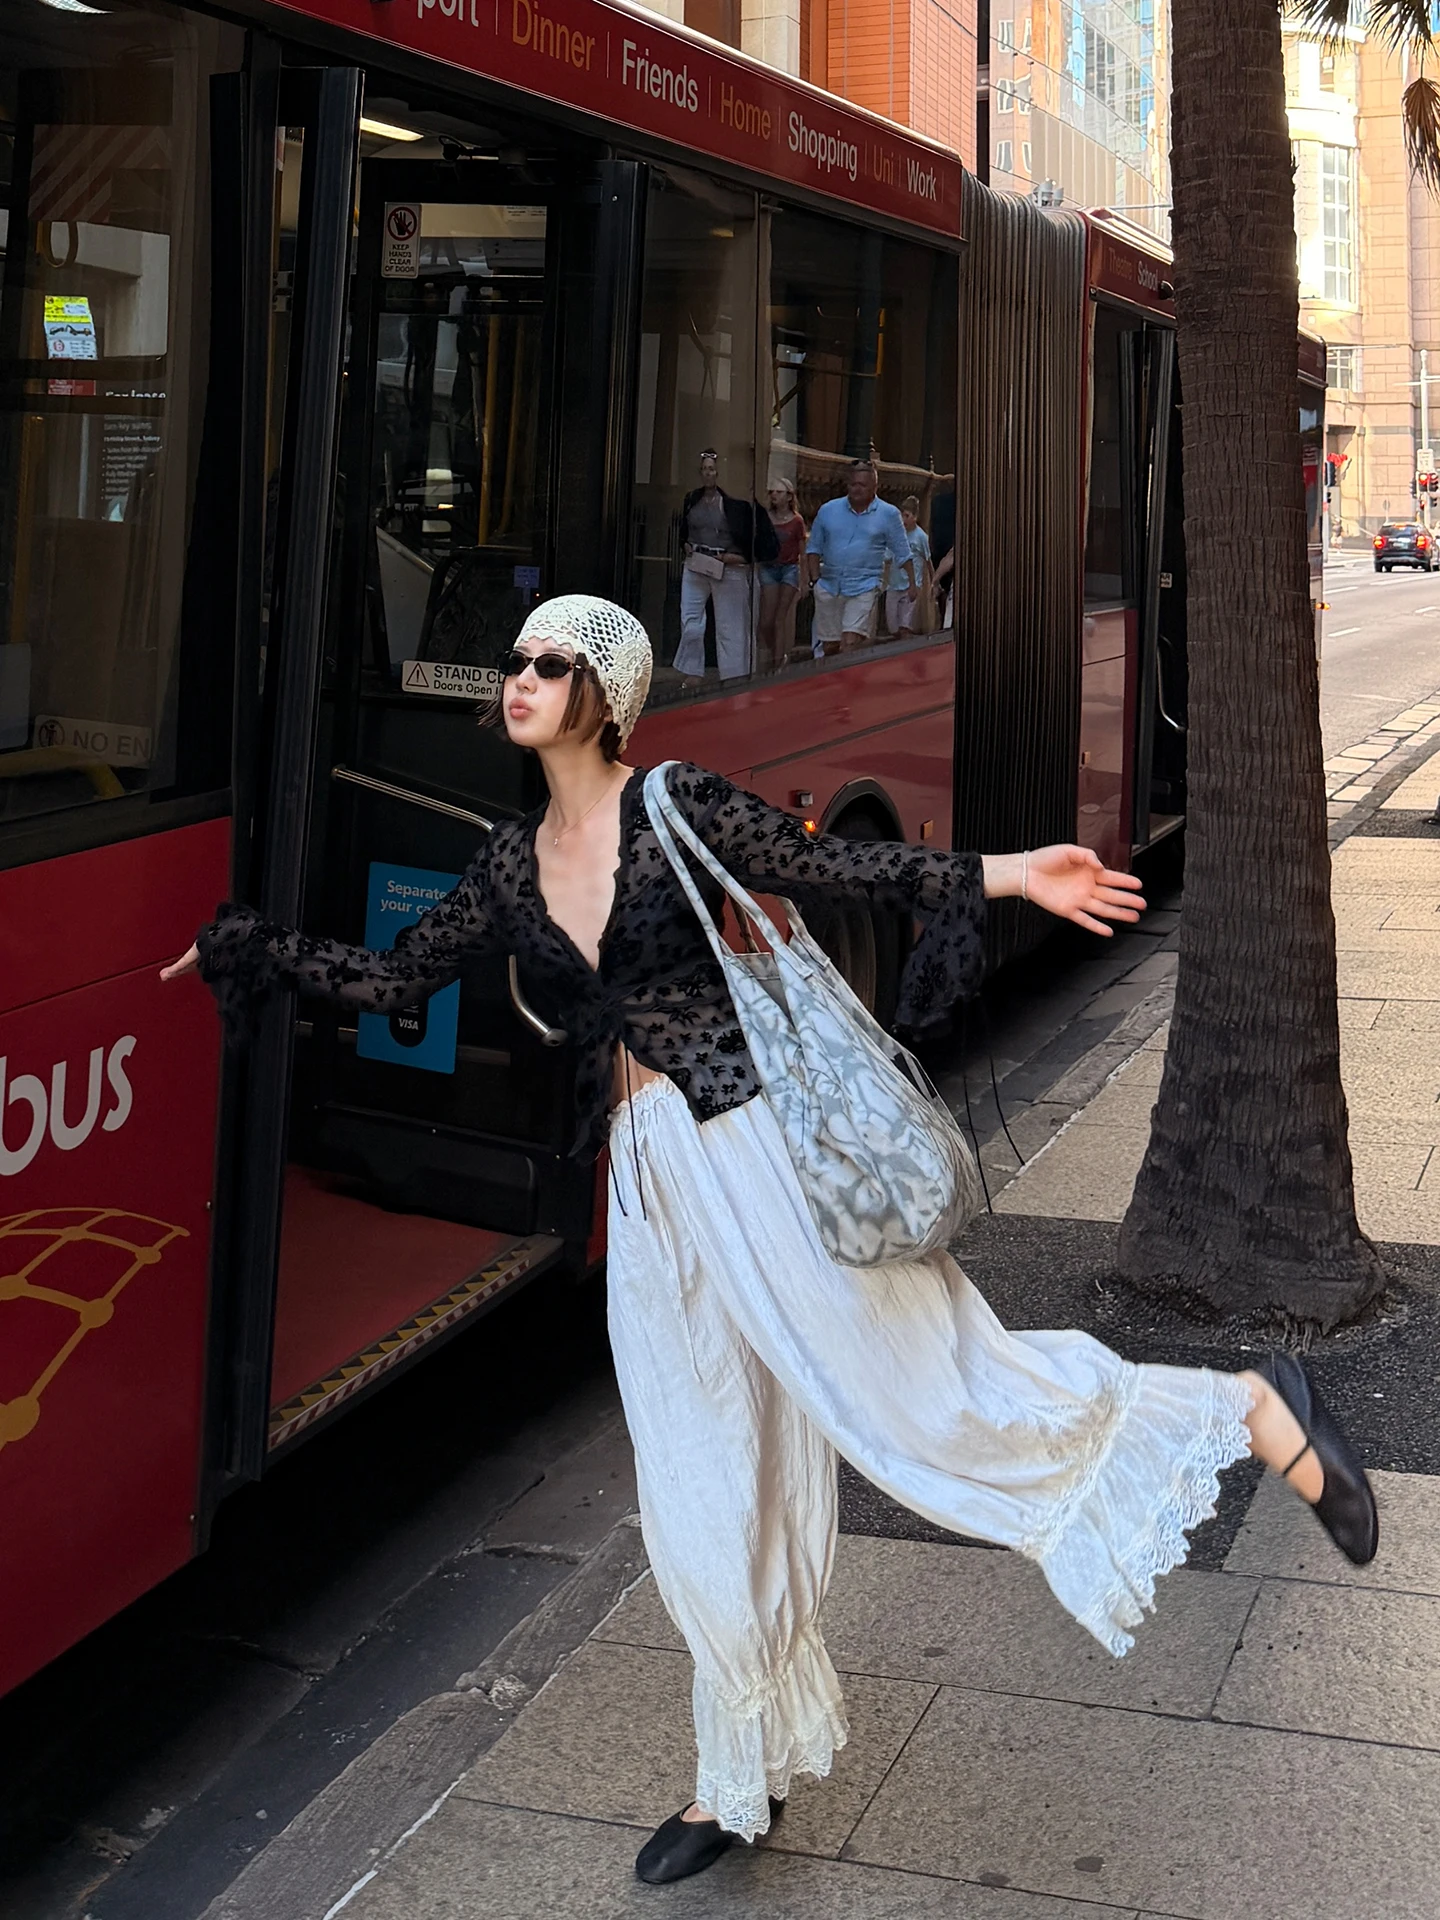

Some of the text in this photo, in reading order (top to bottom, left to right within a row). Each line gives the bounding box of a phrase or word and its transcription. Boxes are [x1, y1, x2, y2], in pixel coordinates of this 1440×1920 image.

[512, 0, 596, 71] Dinner
[622, 38, 698, 113] Friends
[720, 82, 771, 140] Home
[788, 111, 858, 182] Shopping
[873, 145, 894, 185] Uni
[907, 158, 937, 201] Work
[395, 265, 415, 273] DOOR
[1108, 247, 1158, 292] Theatre School
[433, 664, 482, 682] STAND
[433, 680, 463, 692] Doors
[466, 683, 492, 695] Open
[73, 729, 150, 758] NO EN
[387, 880, 447, 900] Separate
[380, 898, 412, 913] your
[398, 1017, 420, 1031] VISA
[0, 1034, 137, 1176] bus
